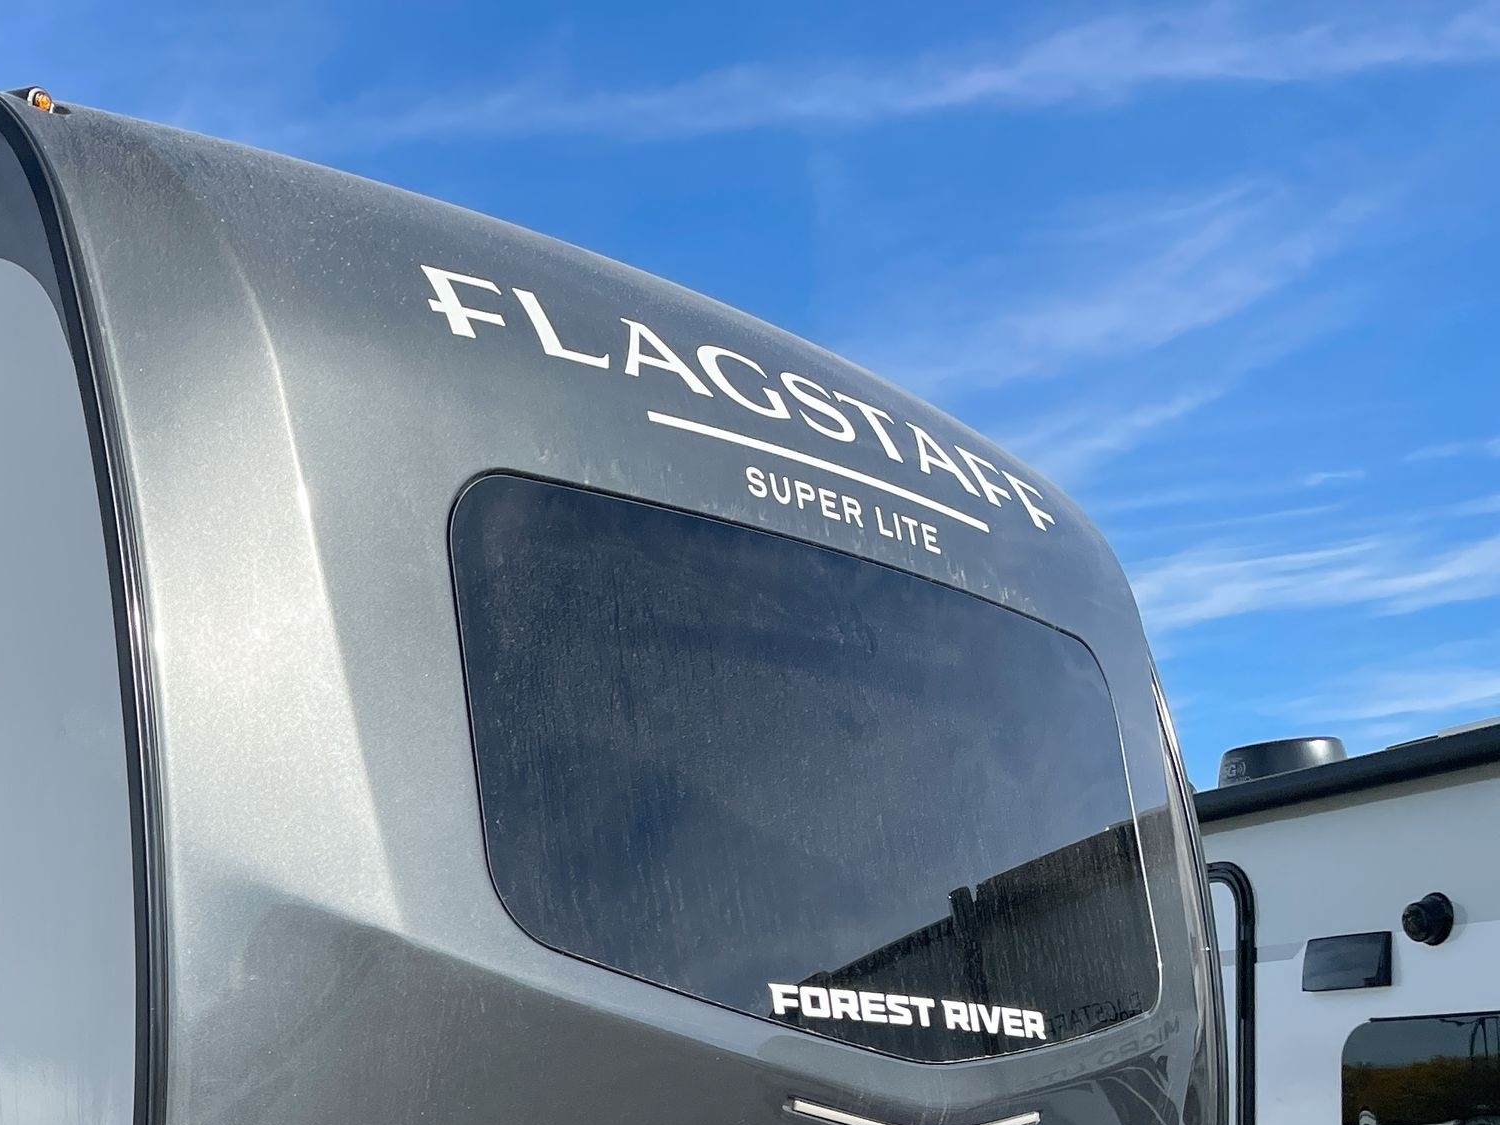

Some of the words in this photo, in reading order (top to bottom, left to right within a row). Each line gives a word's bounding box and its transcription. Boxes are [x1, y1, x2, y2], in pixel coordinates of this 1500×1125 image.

[420, 263, 1055, 532] FLAGSTAFF
[745, 465, 864, 529] SUPER
[876, 503, 942, 555] LITE
[767, 983, 935, 1027] FOREST
[941, 999, 1047, 1040] RIVER
